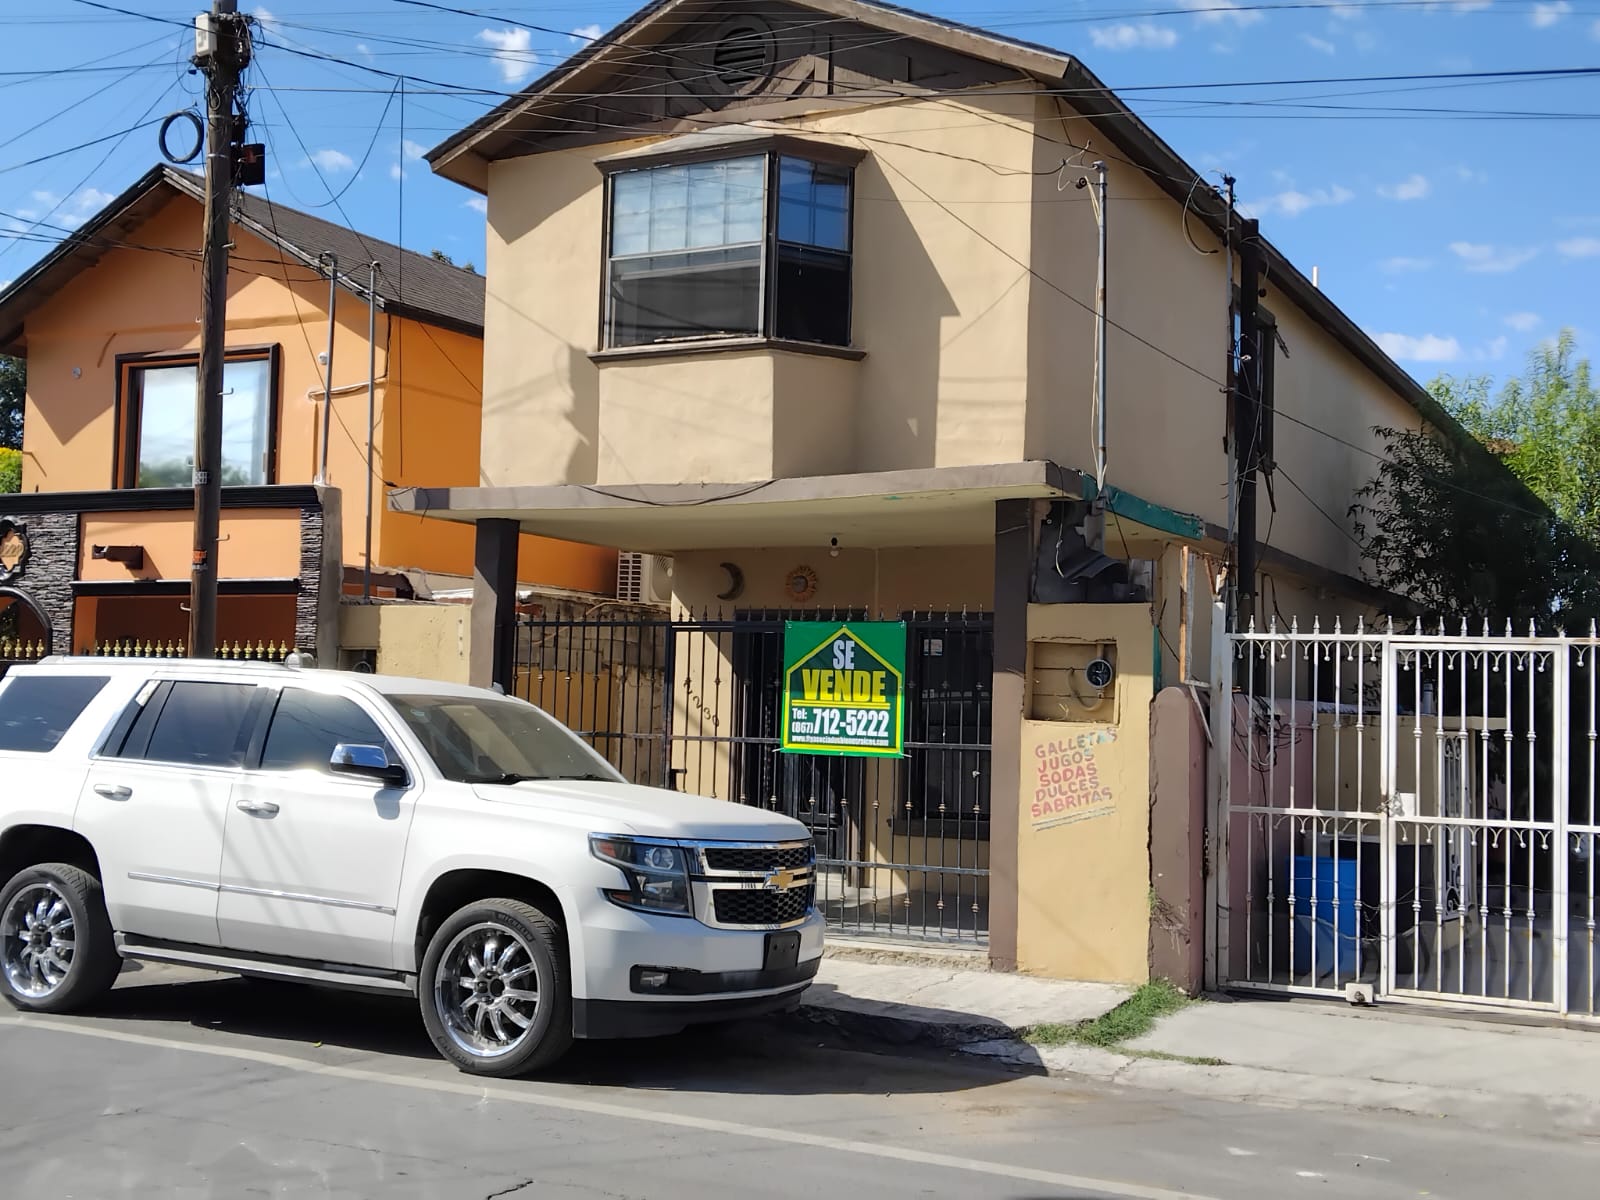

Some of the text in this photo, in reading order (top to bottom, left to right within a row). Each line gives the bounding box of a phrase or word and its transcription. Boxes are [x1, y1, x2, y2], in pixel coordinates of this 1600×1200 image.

[832, 639, 855, 670] SE
[802, 668, 886, 703] VENDE
[792, 707, 808, 720] Tel:
[813, 708, 890, 737] 712-5222
[1038, 747, 1095, 774] JUGOS
[1039, 762, 1097, 788] SODAS
[1031, 786, 1113, 818] SABRITAS
[1035, 776, 1100, 803] DULCES
